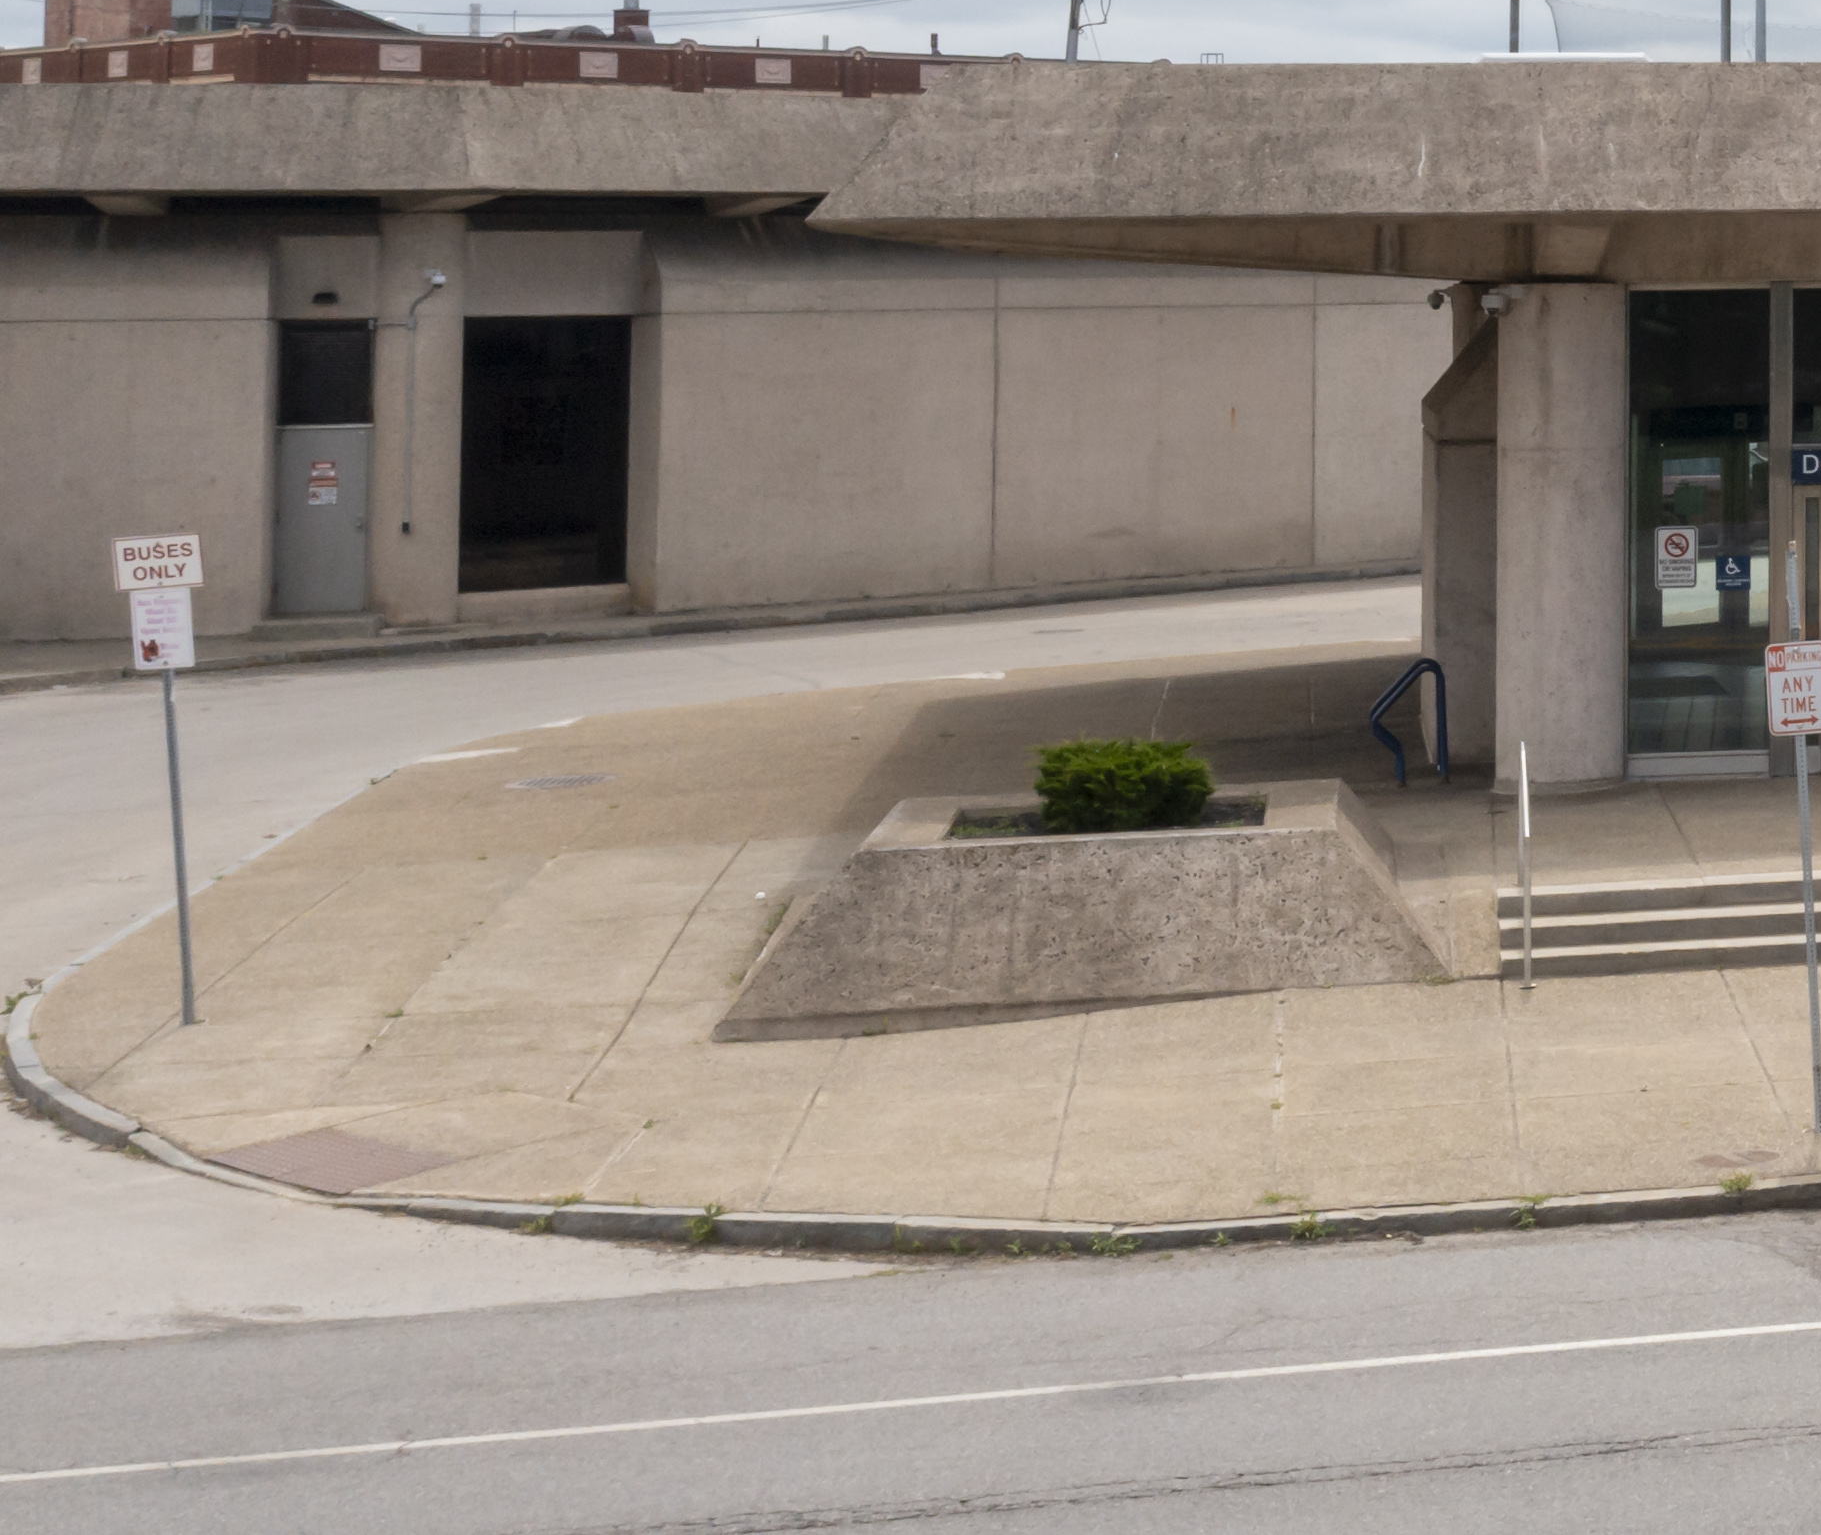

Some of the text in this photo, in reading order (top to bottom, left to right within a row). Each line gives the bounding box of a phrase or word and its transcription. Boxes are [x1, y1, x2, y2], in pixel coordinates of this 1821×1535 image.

[122, 541, 194, 562] BUSES
[132, 563, 187, 581] ONLY
[1768, 650, 1785, 669] NO
[1782, 675, 1814, 693] ANY
[1781, 695, 1817, 714] TIME
